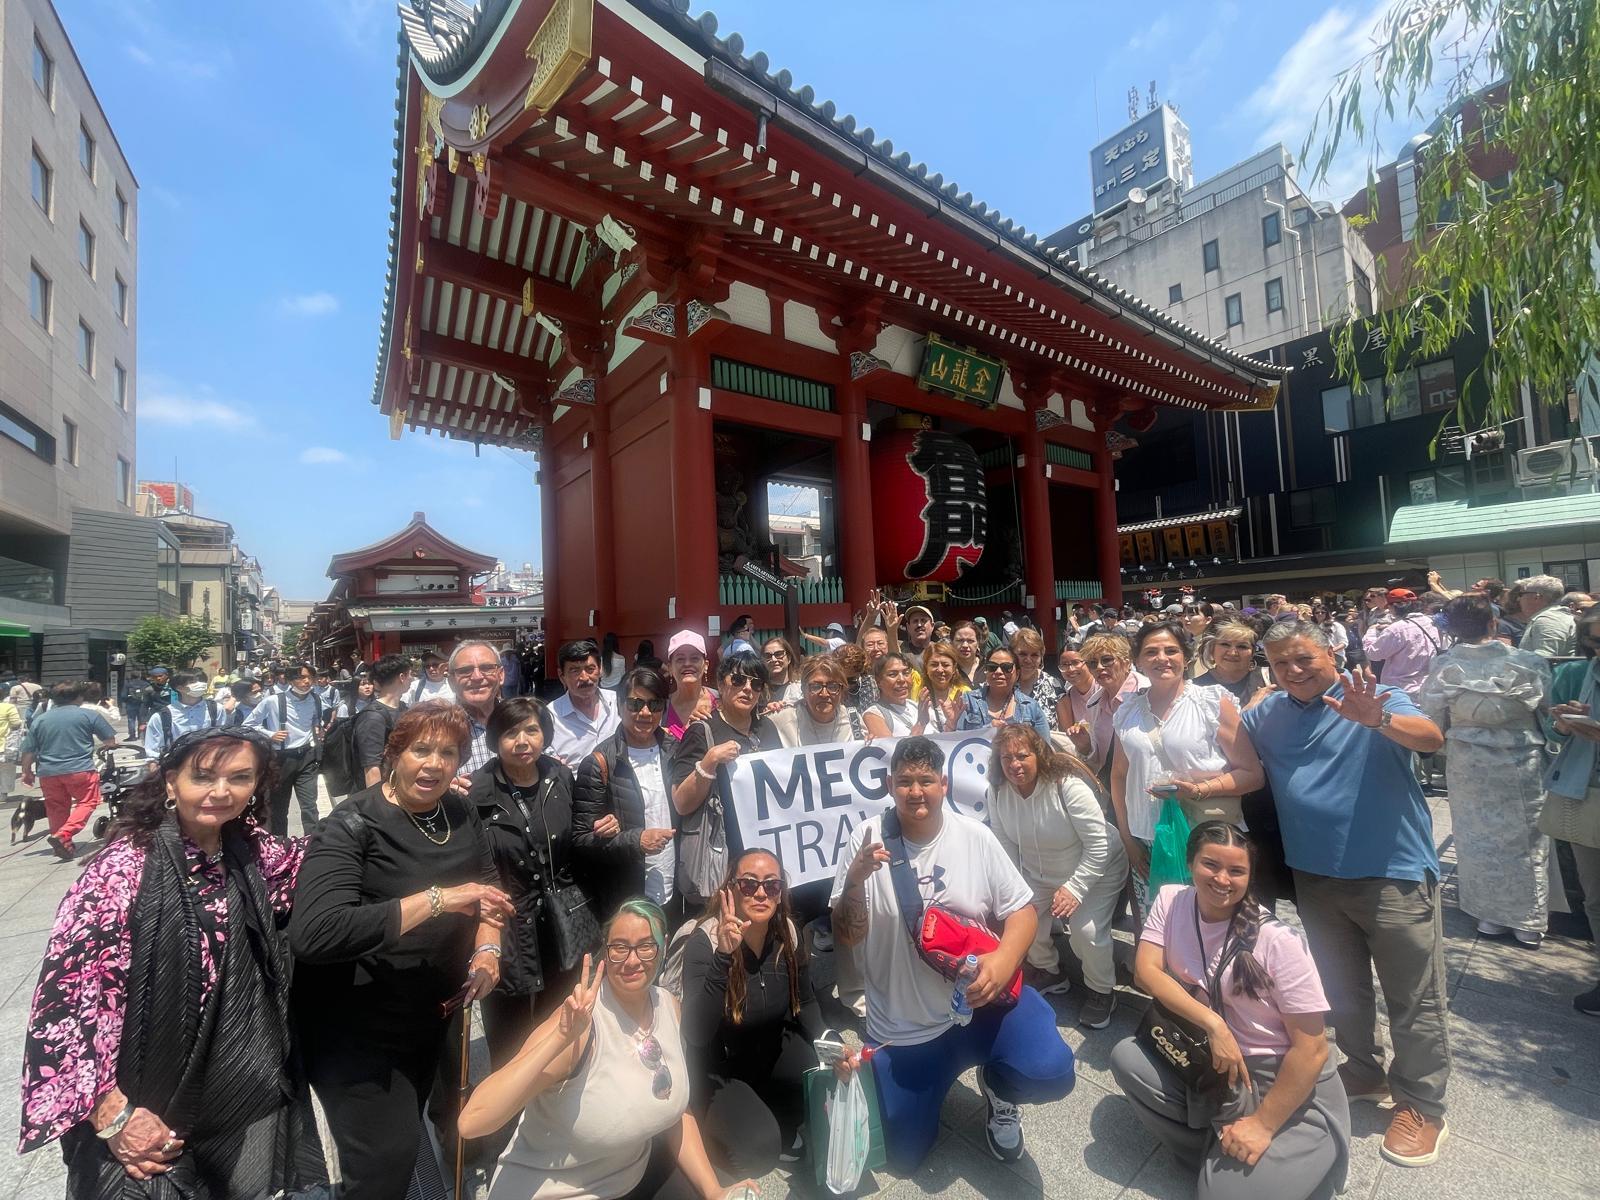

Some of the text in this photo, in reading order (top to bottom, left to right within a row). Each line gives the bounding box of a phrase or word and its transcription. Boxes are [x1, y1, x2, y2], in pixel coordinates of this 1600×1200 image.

[1103, 130, 1149, 166] 天ぷら
[1120, 146, 1161, 184] 三定
[776, 579, 788, 589] GATE
[750, 746, 889, 821] MEG
[758, 809, 868, 873] TRA
[1150, 1026, 1191, 1068] Coach
